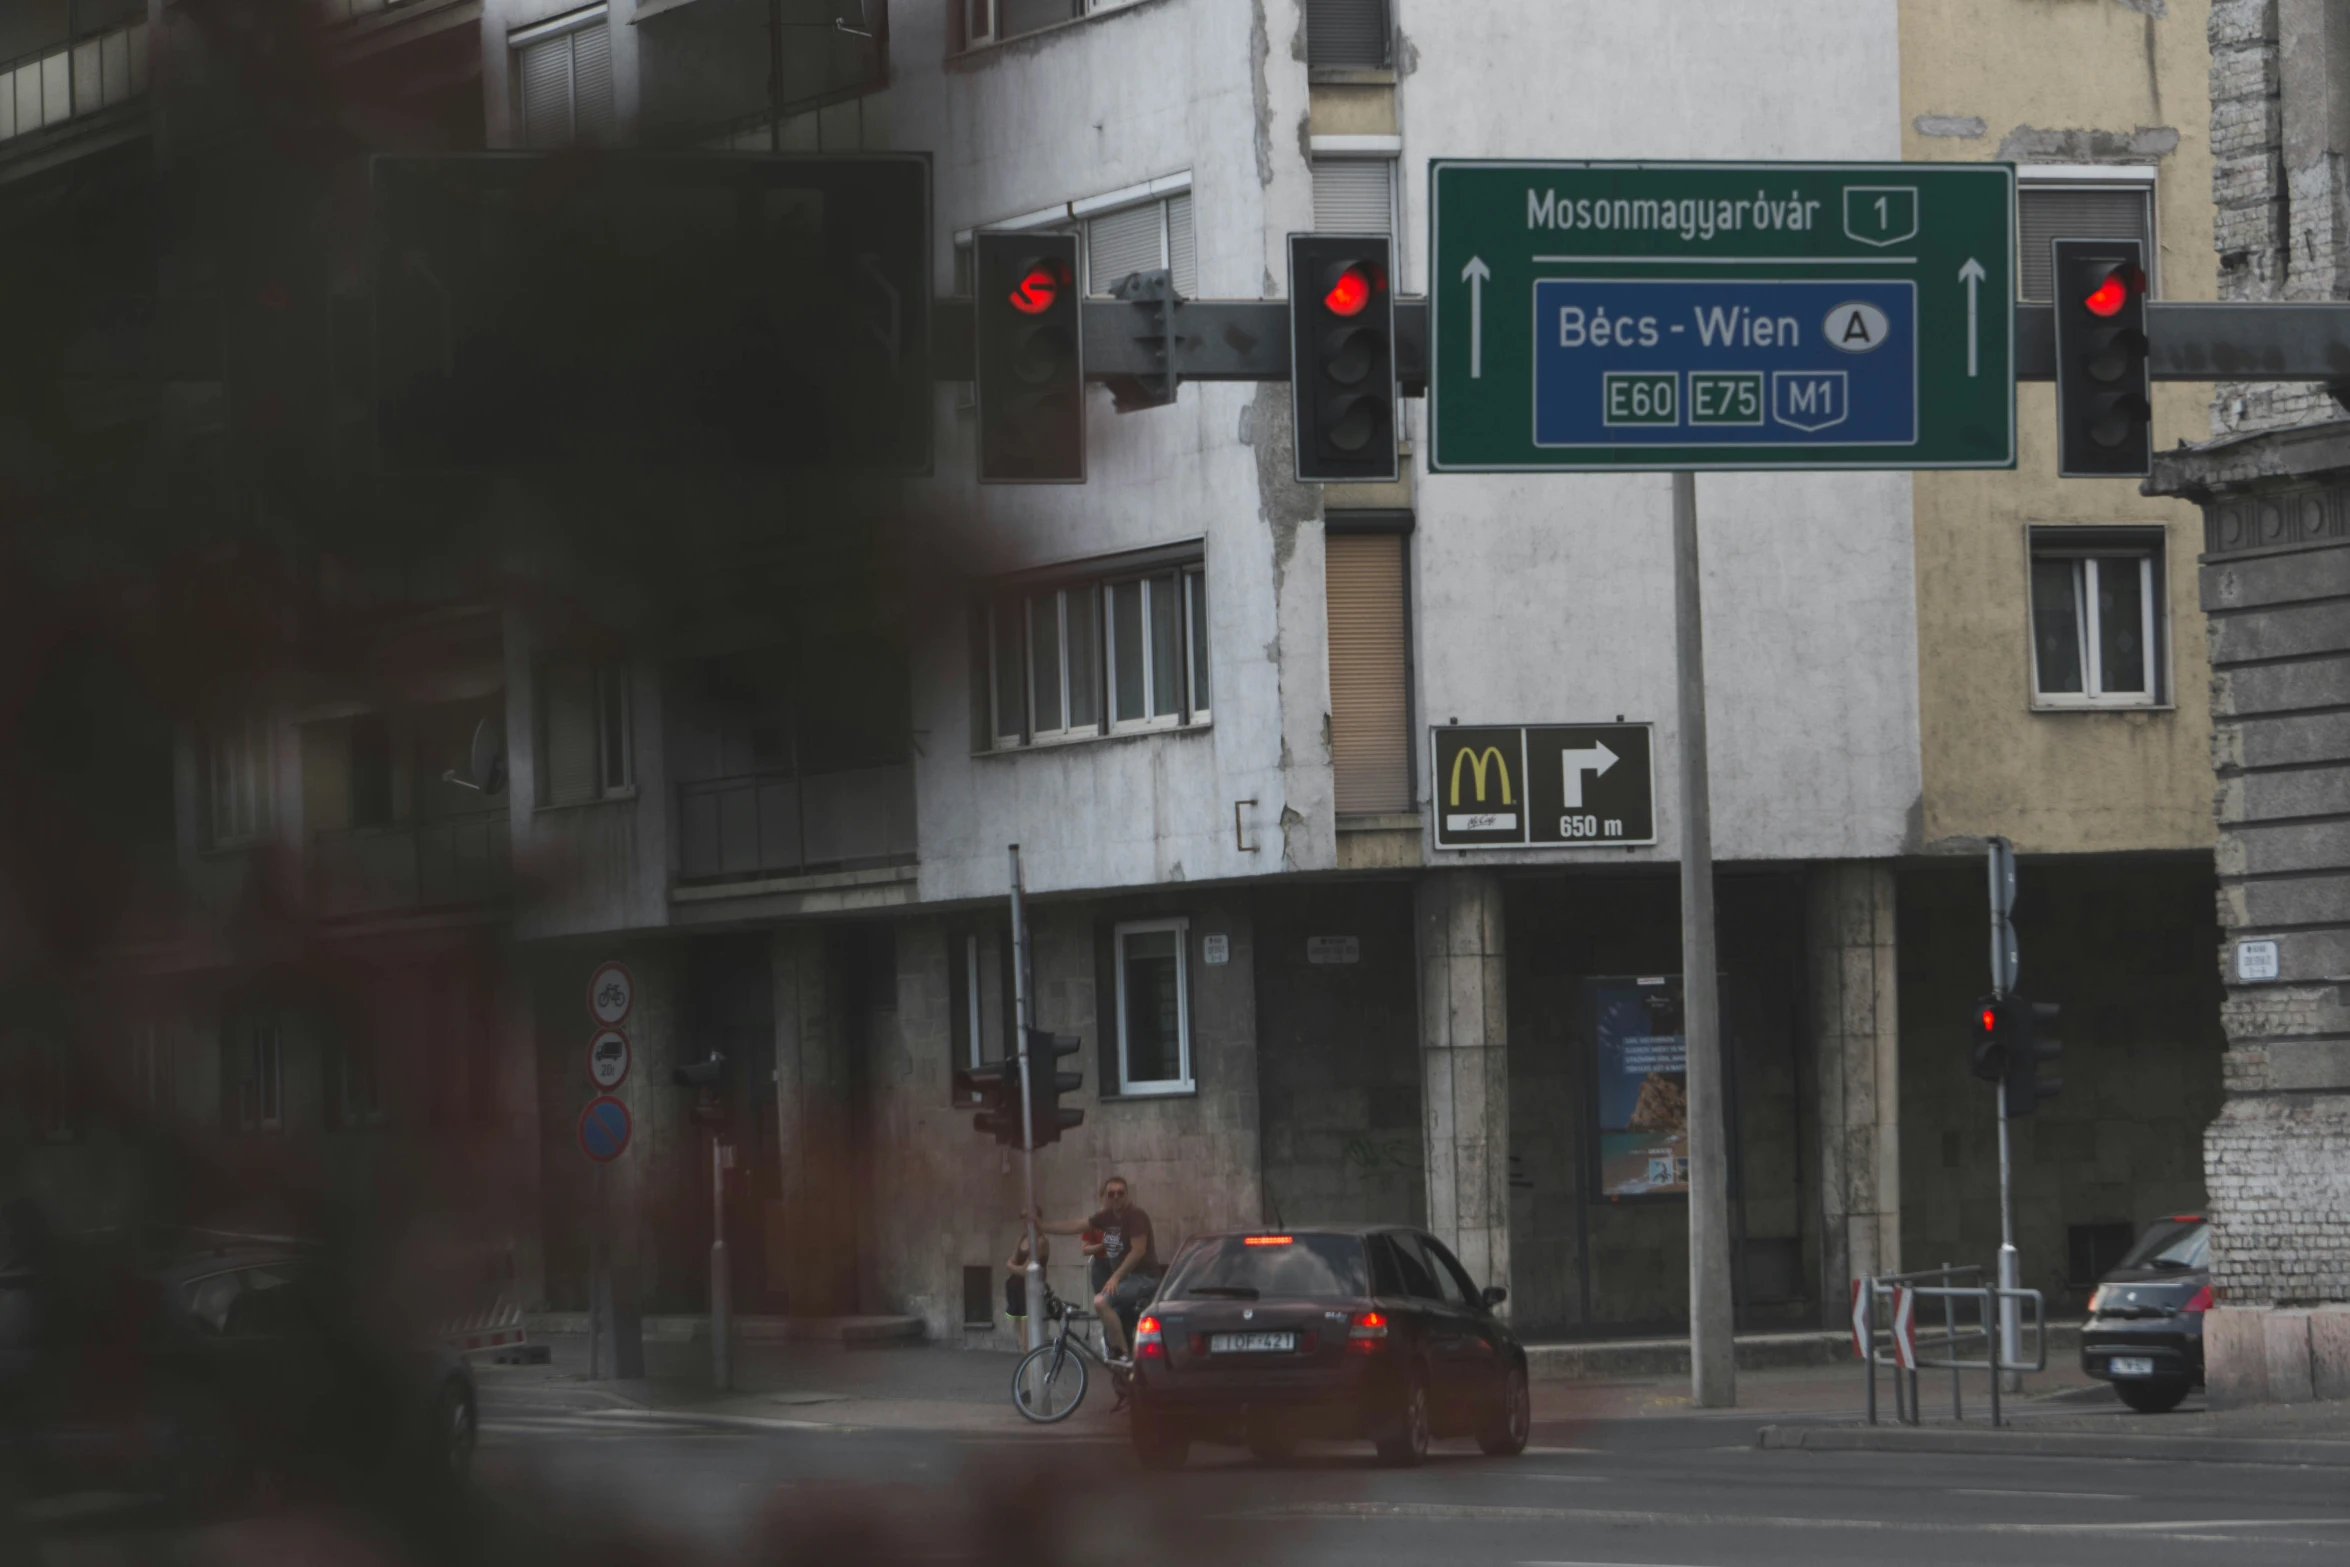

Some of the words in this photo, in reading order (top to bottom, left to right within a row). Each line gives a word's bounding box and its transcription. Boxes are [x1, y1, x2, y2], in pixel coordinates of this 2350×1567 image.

[1528, 189, 1821, 240] Mosonmagyaróvár
[1874, 196, 1888, 230] 1
[1559, 306, 1659, 347] Bécs
[1693, 305, 1800, 347] Wien
[1843, 310, 1871, 343] A
[1610, 381, 1672, 417] E60
[1695, 381, 1757, 416] E75
[1789, 380, 1831, 415] M1
[1559, 815, 1597, 838] 650
[1603, 819, 1623, 837] m
